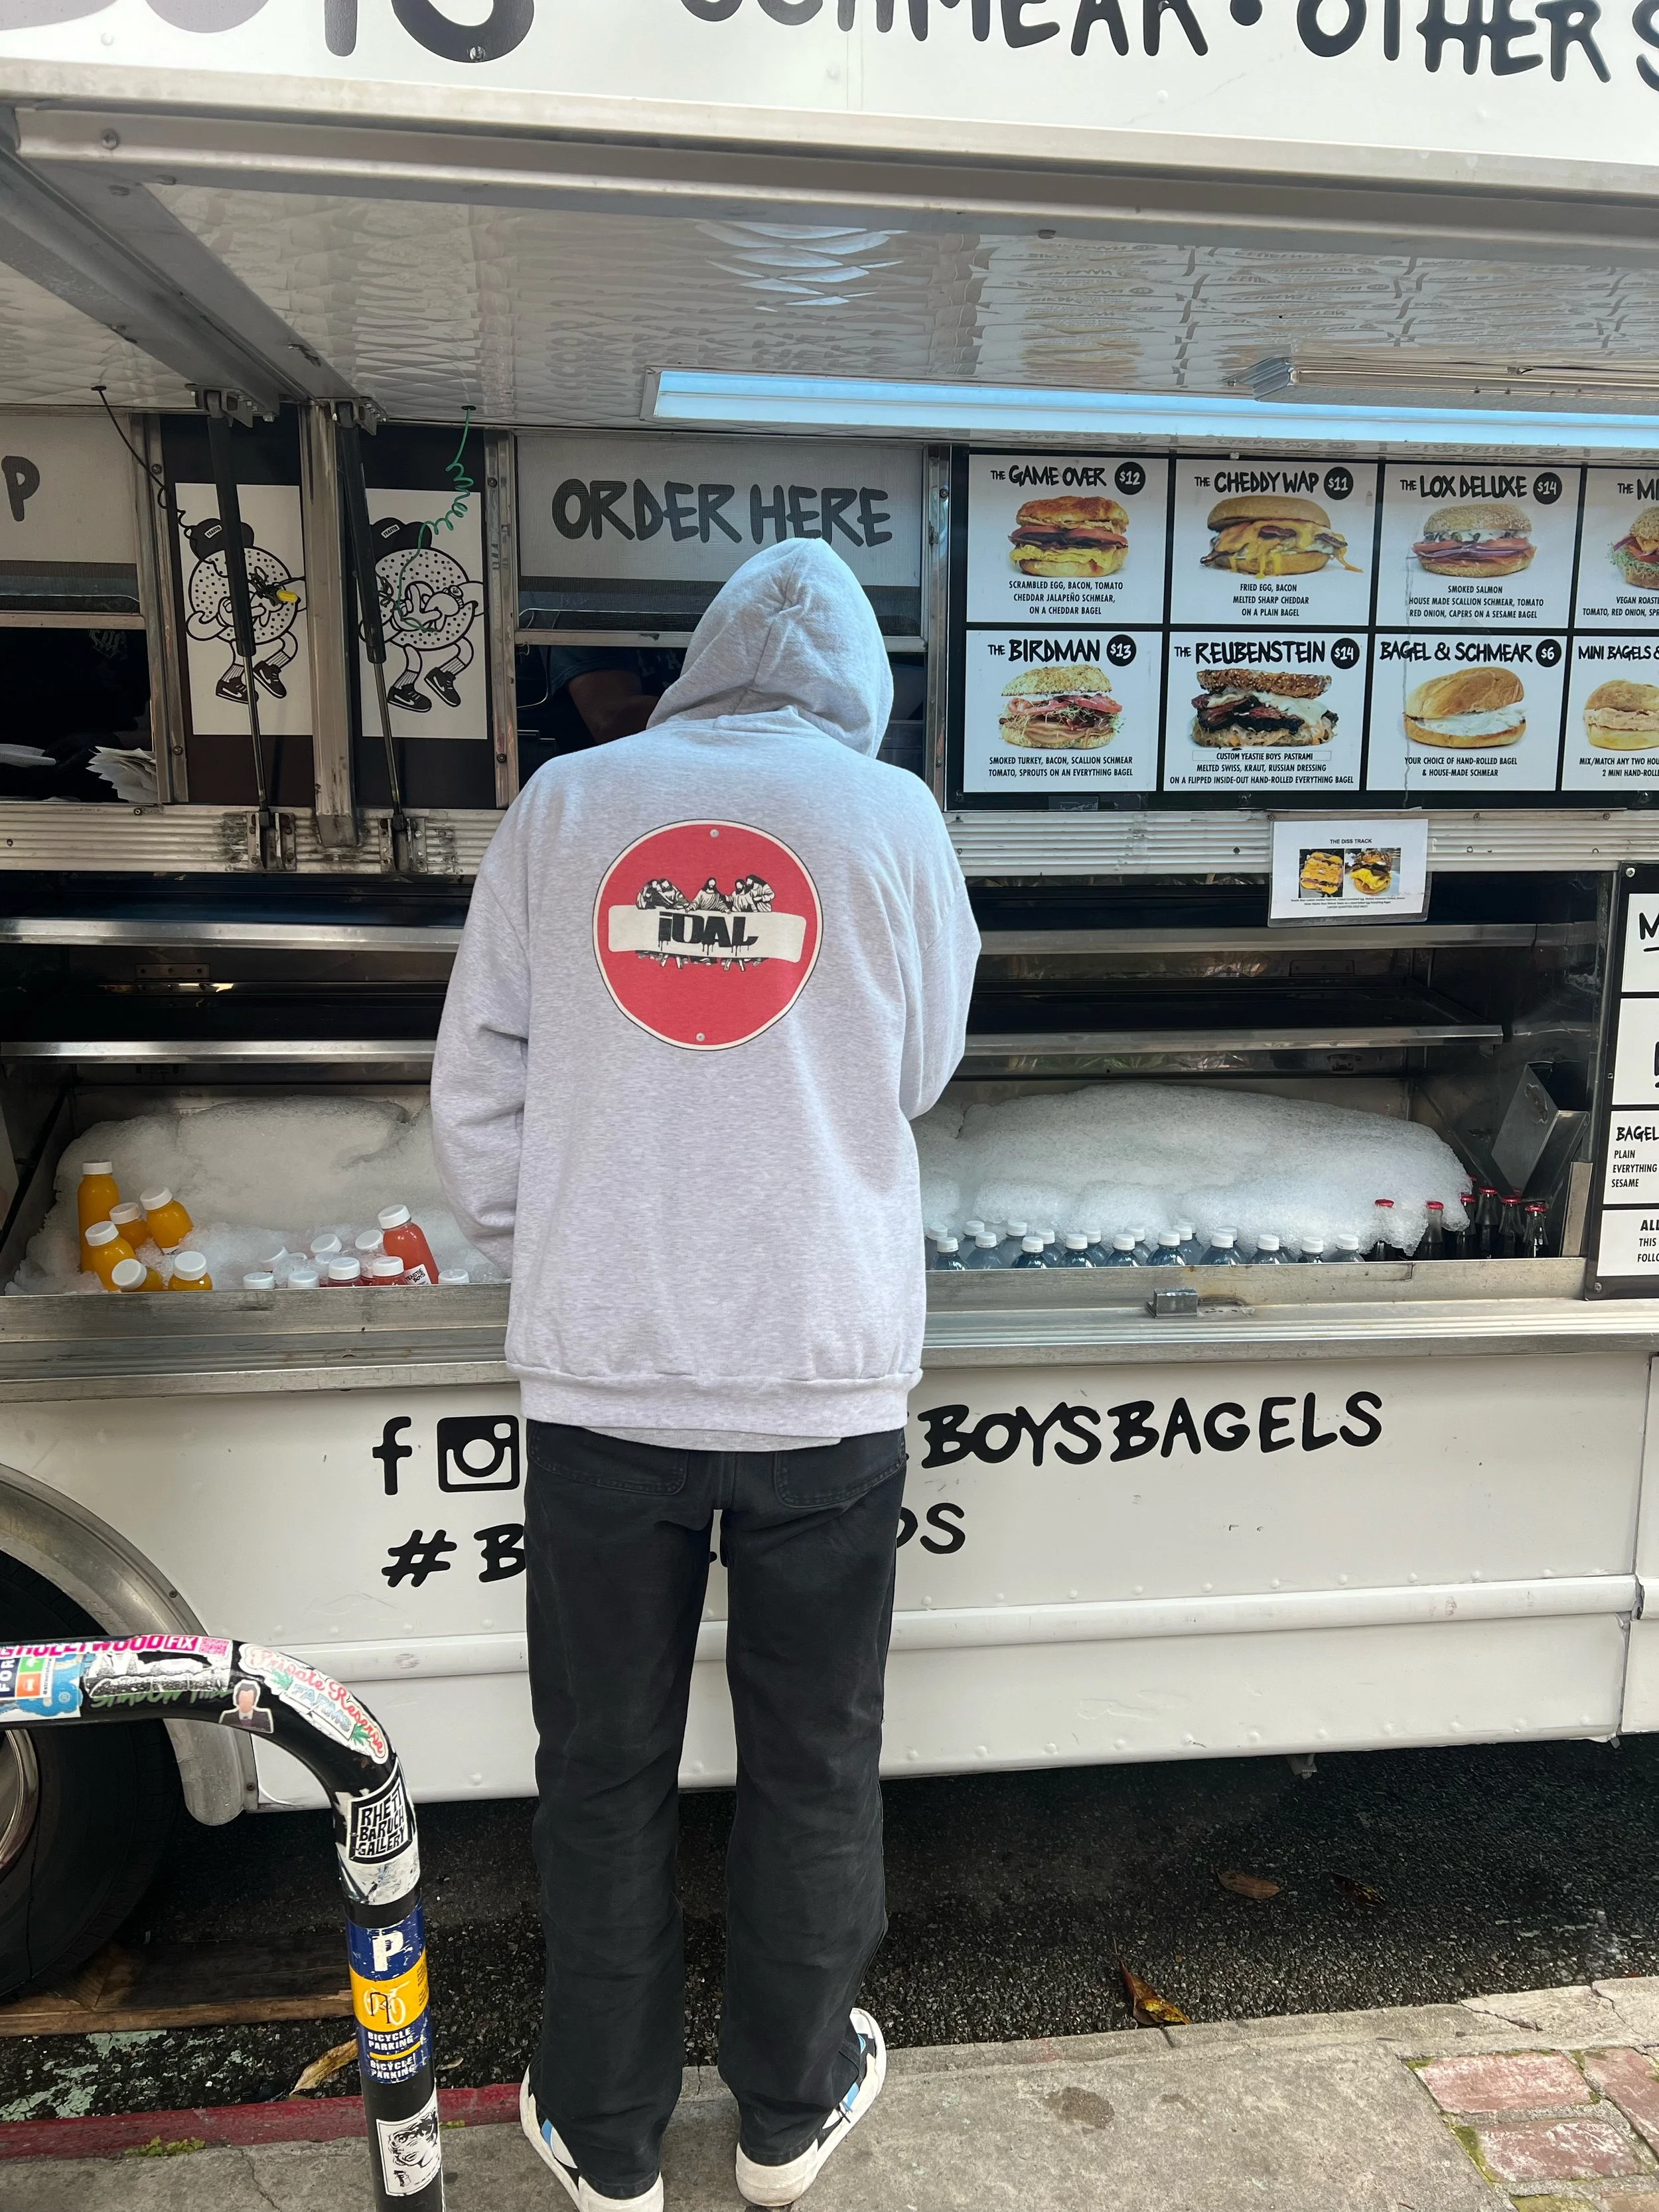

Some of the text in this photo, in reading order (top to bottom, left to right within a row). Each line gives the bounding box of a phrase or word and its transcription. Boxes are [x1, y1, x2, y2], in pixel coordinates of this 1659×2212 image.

[990, 465, 1141, 486] THE GAME OVER $12
[1194, 470, 1348, 493] THE CHEDDY WAP $11
[1400, 475, 1557, 498] THE LOX DELUXE $14
[1617, 483, 1634, 494] THE
[552, 478, 893, 548] ORDER HERE
[1050, 581, 1065, 590] EGG,
[1068, 581, 1092, 590] BACON,
[1095, 581, 1123, 590] TOMATO
[1240, 583, 1258, 592] FRIED
[1259, 584, 1273, 593] EGG,
[1046, 593, 1080, 602] JALAPEÑO
[1082, 594, 1116, 603] SCHMEAR,
[1483, 598, 1514, 607] SCHMEAR,
[1423, 610, 1447, 619] ONION,
[1583, 608, 1609, 617] TOMATO,
[1625, 609, 1646, 617] ONION,
[987, 638, 1131, 662] THE BIRDMAN $13
[1174, 640, 1354, 664] THE REUBENSTEIN $14
[1379, 640, 1555, 663] BAGEL & SCHMEAR $6
[1578, 645, 1605, 660] MINI
[1608, 645, 1652, 661] BAGELS
[1018, 757, 1043, 766] TURKEY,
[1046, 757, 1069, 766] BACON,
[1404, 757, 1422, 765] YOUR
[1423, 757, 1443, 765] CHOICE
[1445, 757, 1455, 765] OF
[1456, 757, 1498, 765] HAND-ROLLED
[1579, 757, 1615, 766] MIX/MATCH
[988, 769, 1017, 778] TOMATO,
[1221, 764, 1242, 773] SWISS,
[1244, 764, 1266, 773] KRAUT,
[1470, 769, 1498, 777] SCHMEAR
[1614, 1149, 1636, 1159] PLAIN
[1613, 1164, 1657, 1173] EVERYTHING
[1611, 1179, 1639, 1188] SESAME
[1639, 1237, 1657, 1247] THIS
[169, 1636, 196, 1650] FIX
[292, 1684, 352, 1732] FARMS
[359, 1806, 405, 1842] BARUCH
[358, 1826, 405, 1856] GALLERY
[372, 1930, 404, 1972] P
[367, 2027, 411, 2041] BICYCLE
[368, 2037, 414, 2051] PARKING
[370, 2056, 413, 2071] BICYCLE
[371, 2065, 415, 2080] PARKING
